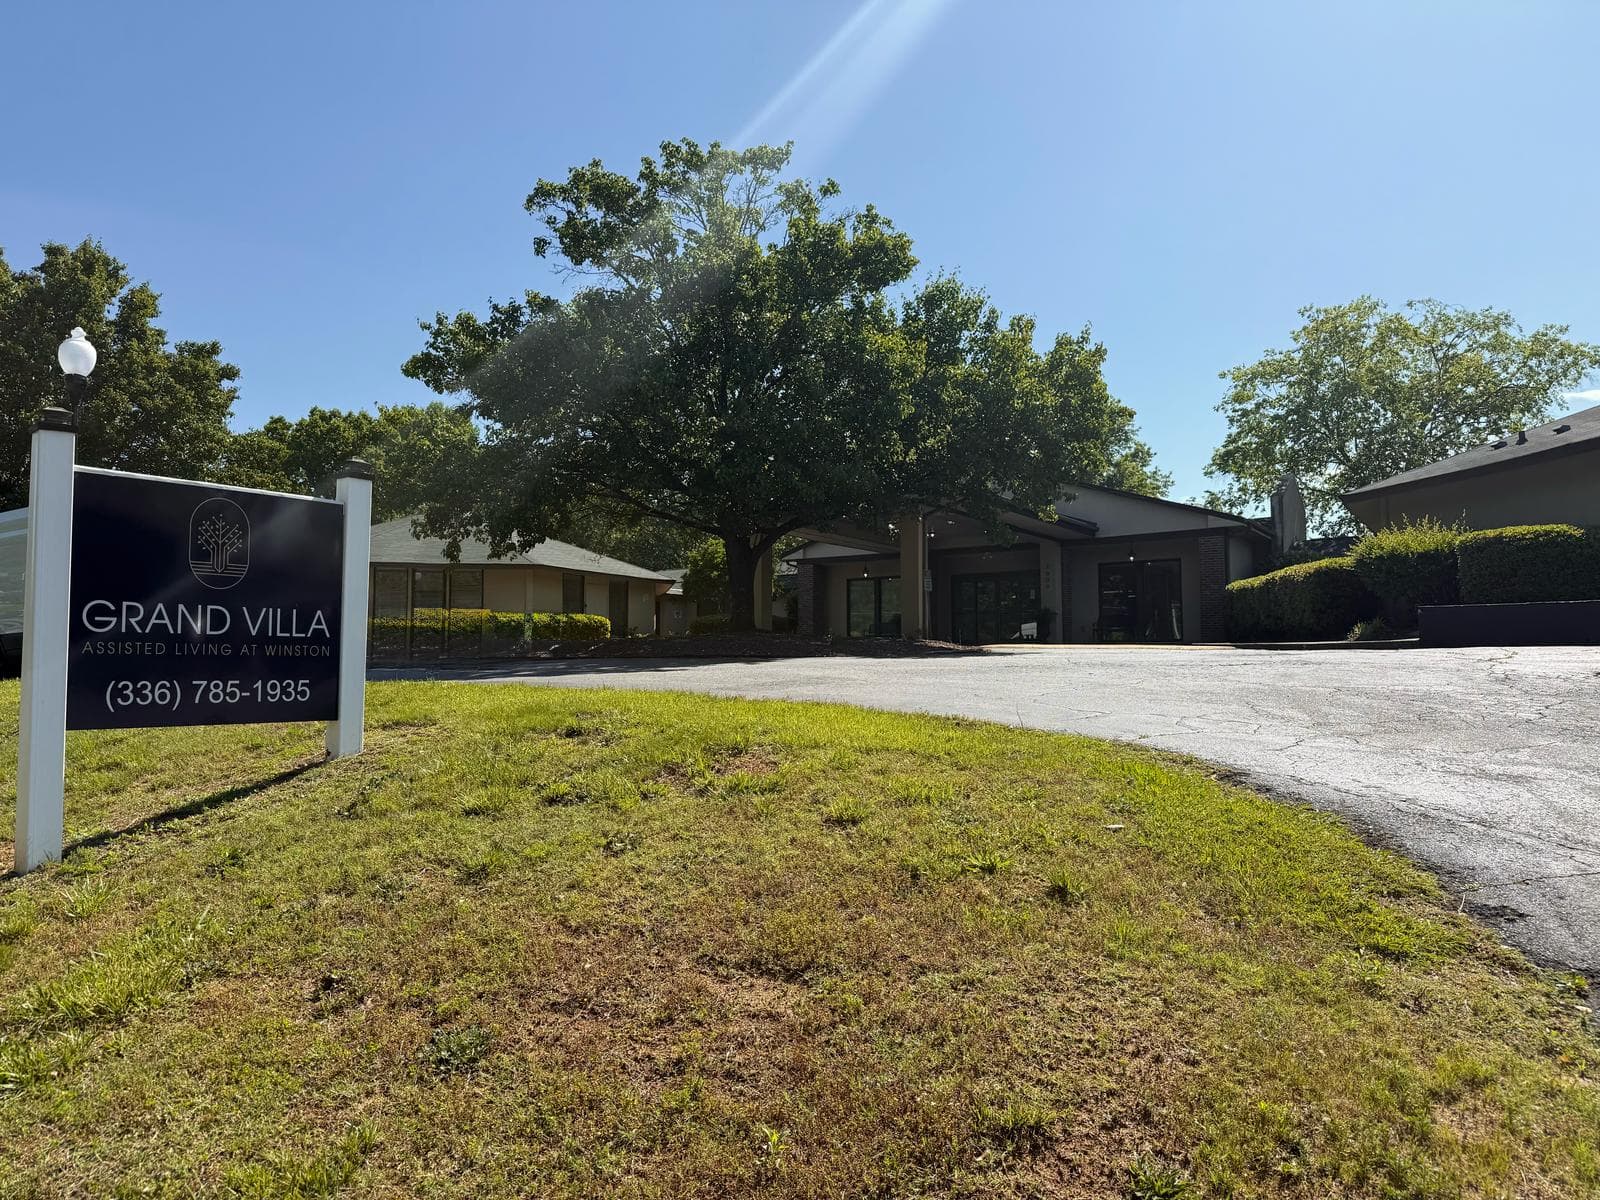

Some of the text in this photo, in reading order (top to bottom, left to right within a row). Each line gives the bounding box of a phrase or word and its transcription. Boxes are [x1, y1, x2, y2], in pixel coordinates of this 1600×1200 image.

[82, 599, 331, 638] GRAND VILLA
[81, 640, 331, 657] ASSISTED LIVING AT WINSTON
[105, 679, 311, 713] (336) 785-1935
